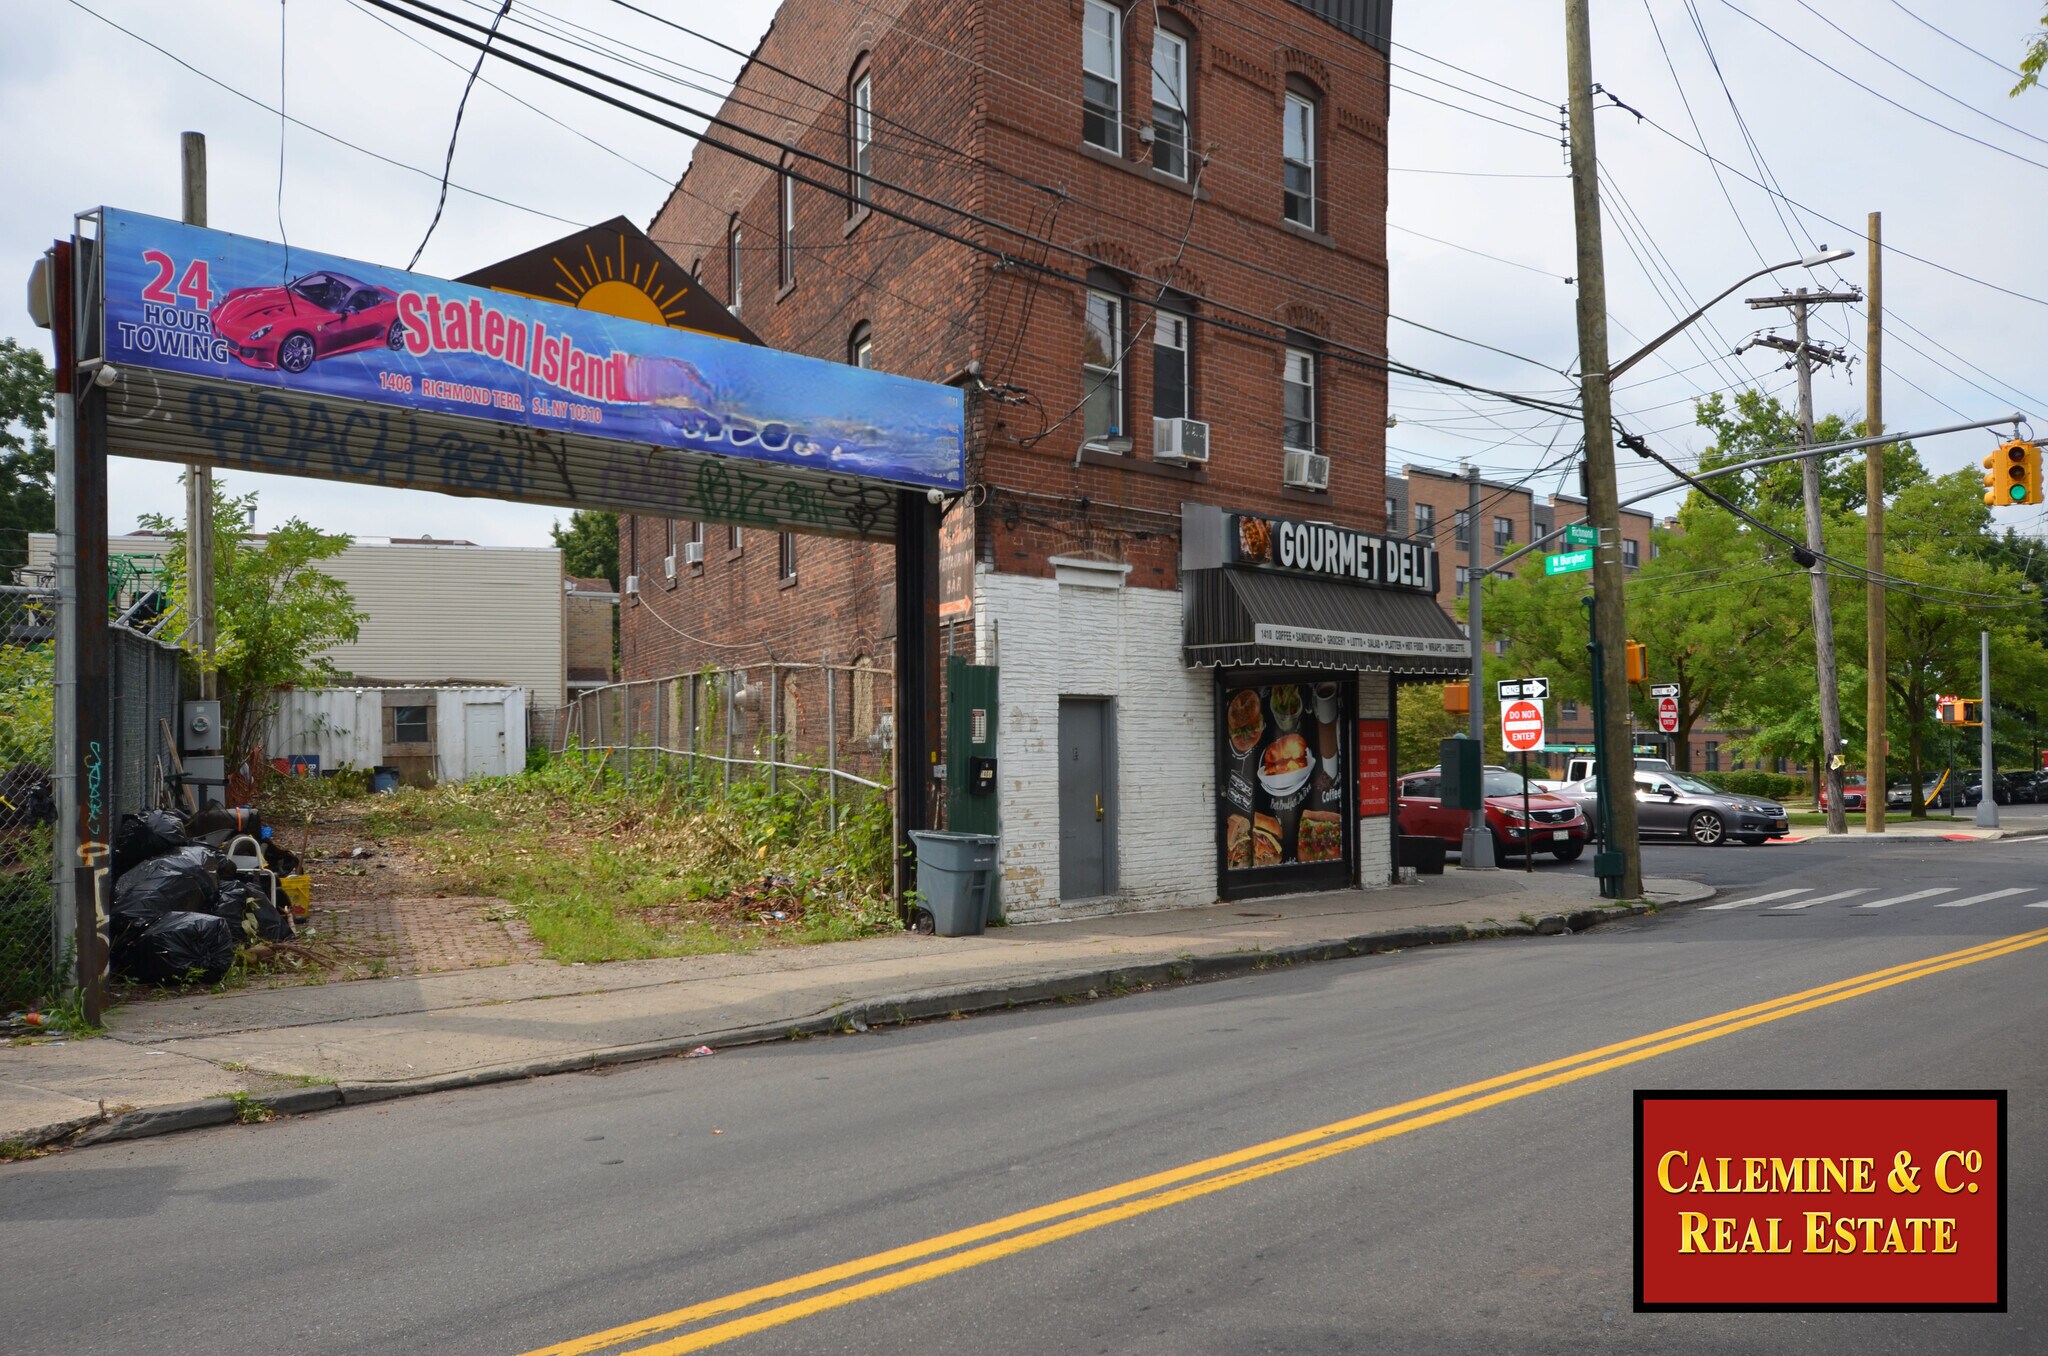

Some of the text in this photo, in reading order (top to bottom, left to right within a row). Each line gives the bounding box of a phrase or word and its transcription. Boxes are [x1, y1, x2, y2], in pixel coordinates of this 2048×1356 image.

[142, 250, 213, 310] 24
[143, 304, 210, 334] HOUR
[118, 322, 229, 365] TOWING
[398, 290, 625, 402] Staten Island
[379, 372, 602, 424] 1406 RICHMOND TERR. S.I. NY 10310
[1571, 526, 1594, 540] Richmond
[1279, 521, 1432, 588] GOURMET DELI
[1552, 553, 1586, 567] N Burgher
[946, 577, 962, 595] BAR
[1261, 629, 1273, 640] 1410
[1275, 630, 1292, 642] COFFEE
[1296, 632, 1323, 645] SANDWICHES
[1327, 634, 1346, 646] GROCERY
[1350, 636, 1363, 648] LOTTO
[1367, 638, 1380, 649] SALAD
[1385, 640, 1402, 651] PLATTER
[1413, 641, 1424, 652] FOOD
[1428, 642, 1442, 653] WRAPS
[1505, 685, 1539, 695] ONE WAY
[1509, 710, 1536, 720] DO NOT
[1512, 732, 1536, 742] ENTER
[1321, 786, 1342, 803] Coffee
